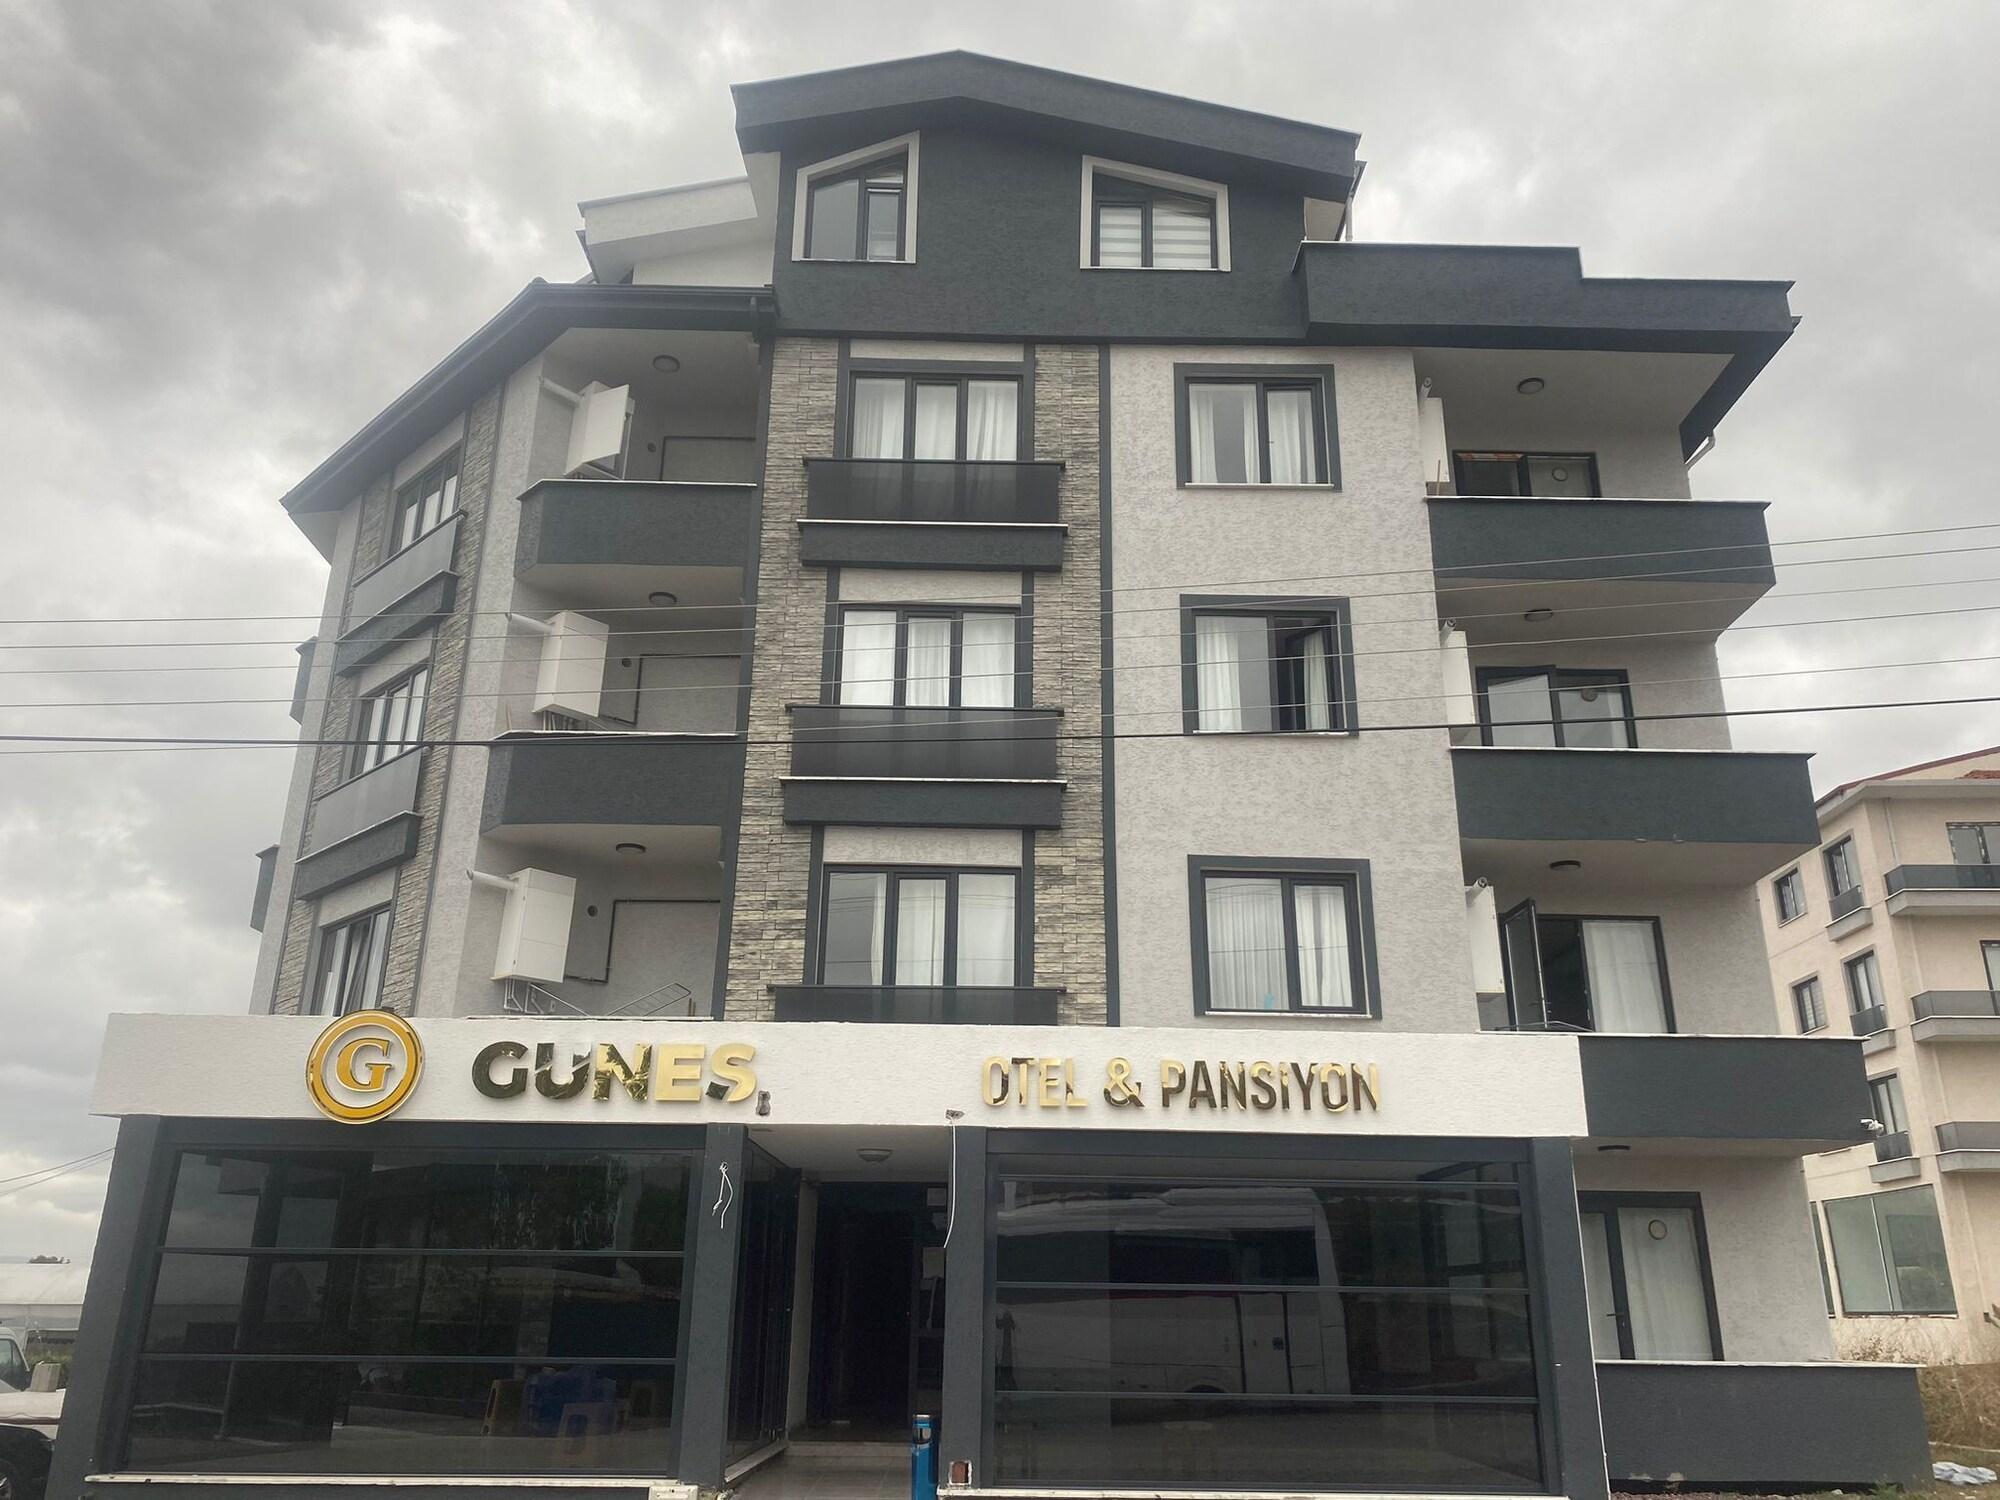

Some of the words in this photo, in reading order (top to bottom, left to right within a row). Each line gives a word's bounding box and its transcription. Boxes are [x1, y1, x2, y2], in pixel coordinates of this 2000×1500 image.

[335, 1036, 393, 1092] G
[471, 1041, 757, 1103] GUNES
[983, 1056, 1088, 1107] OTEL
[1103, 1056, 1145, 1109] &
